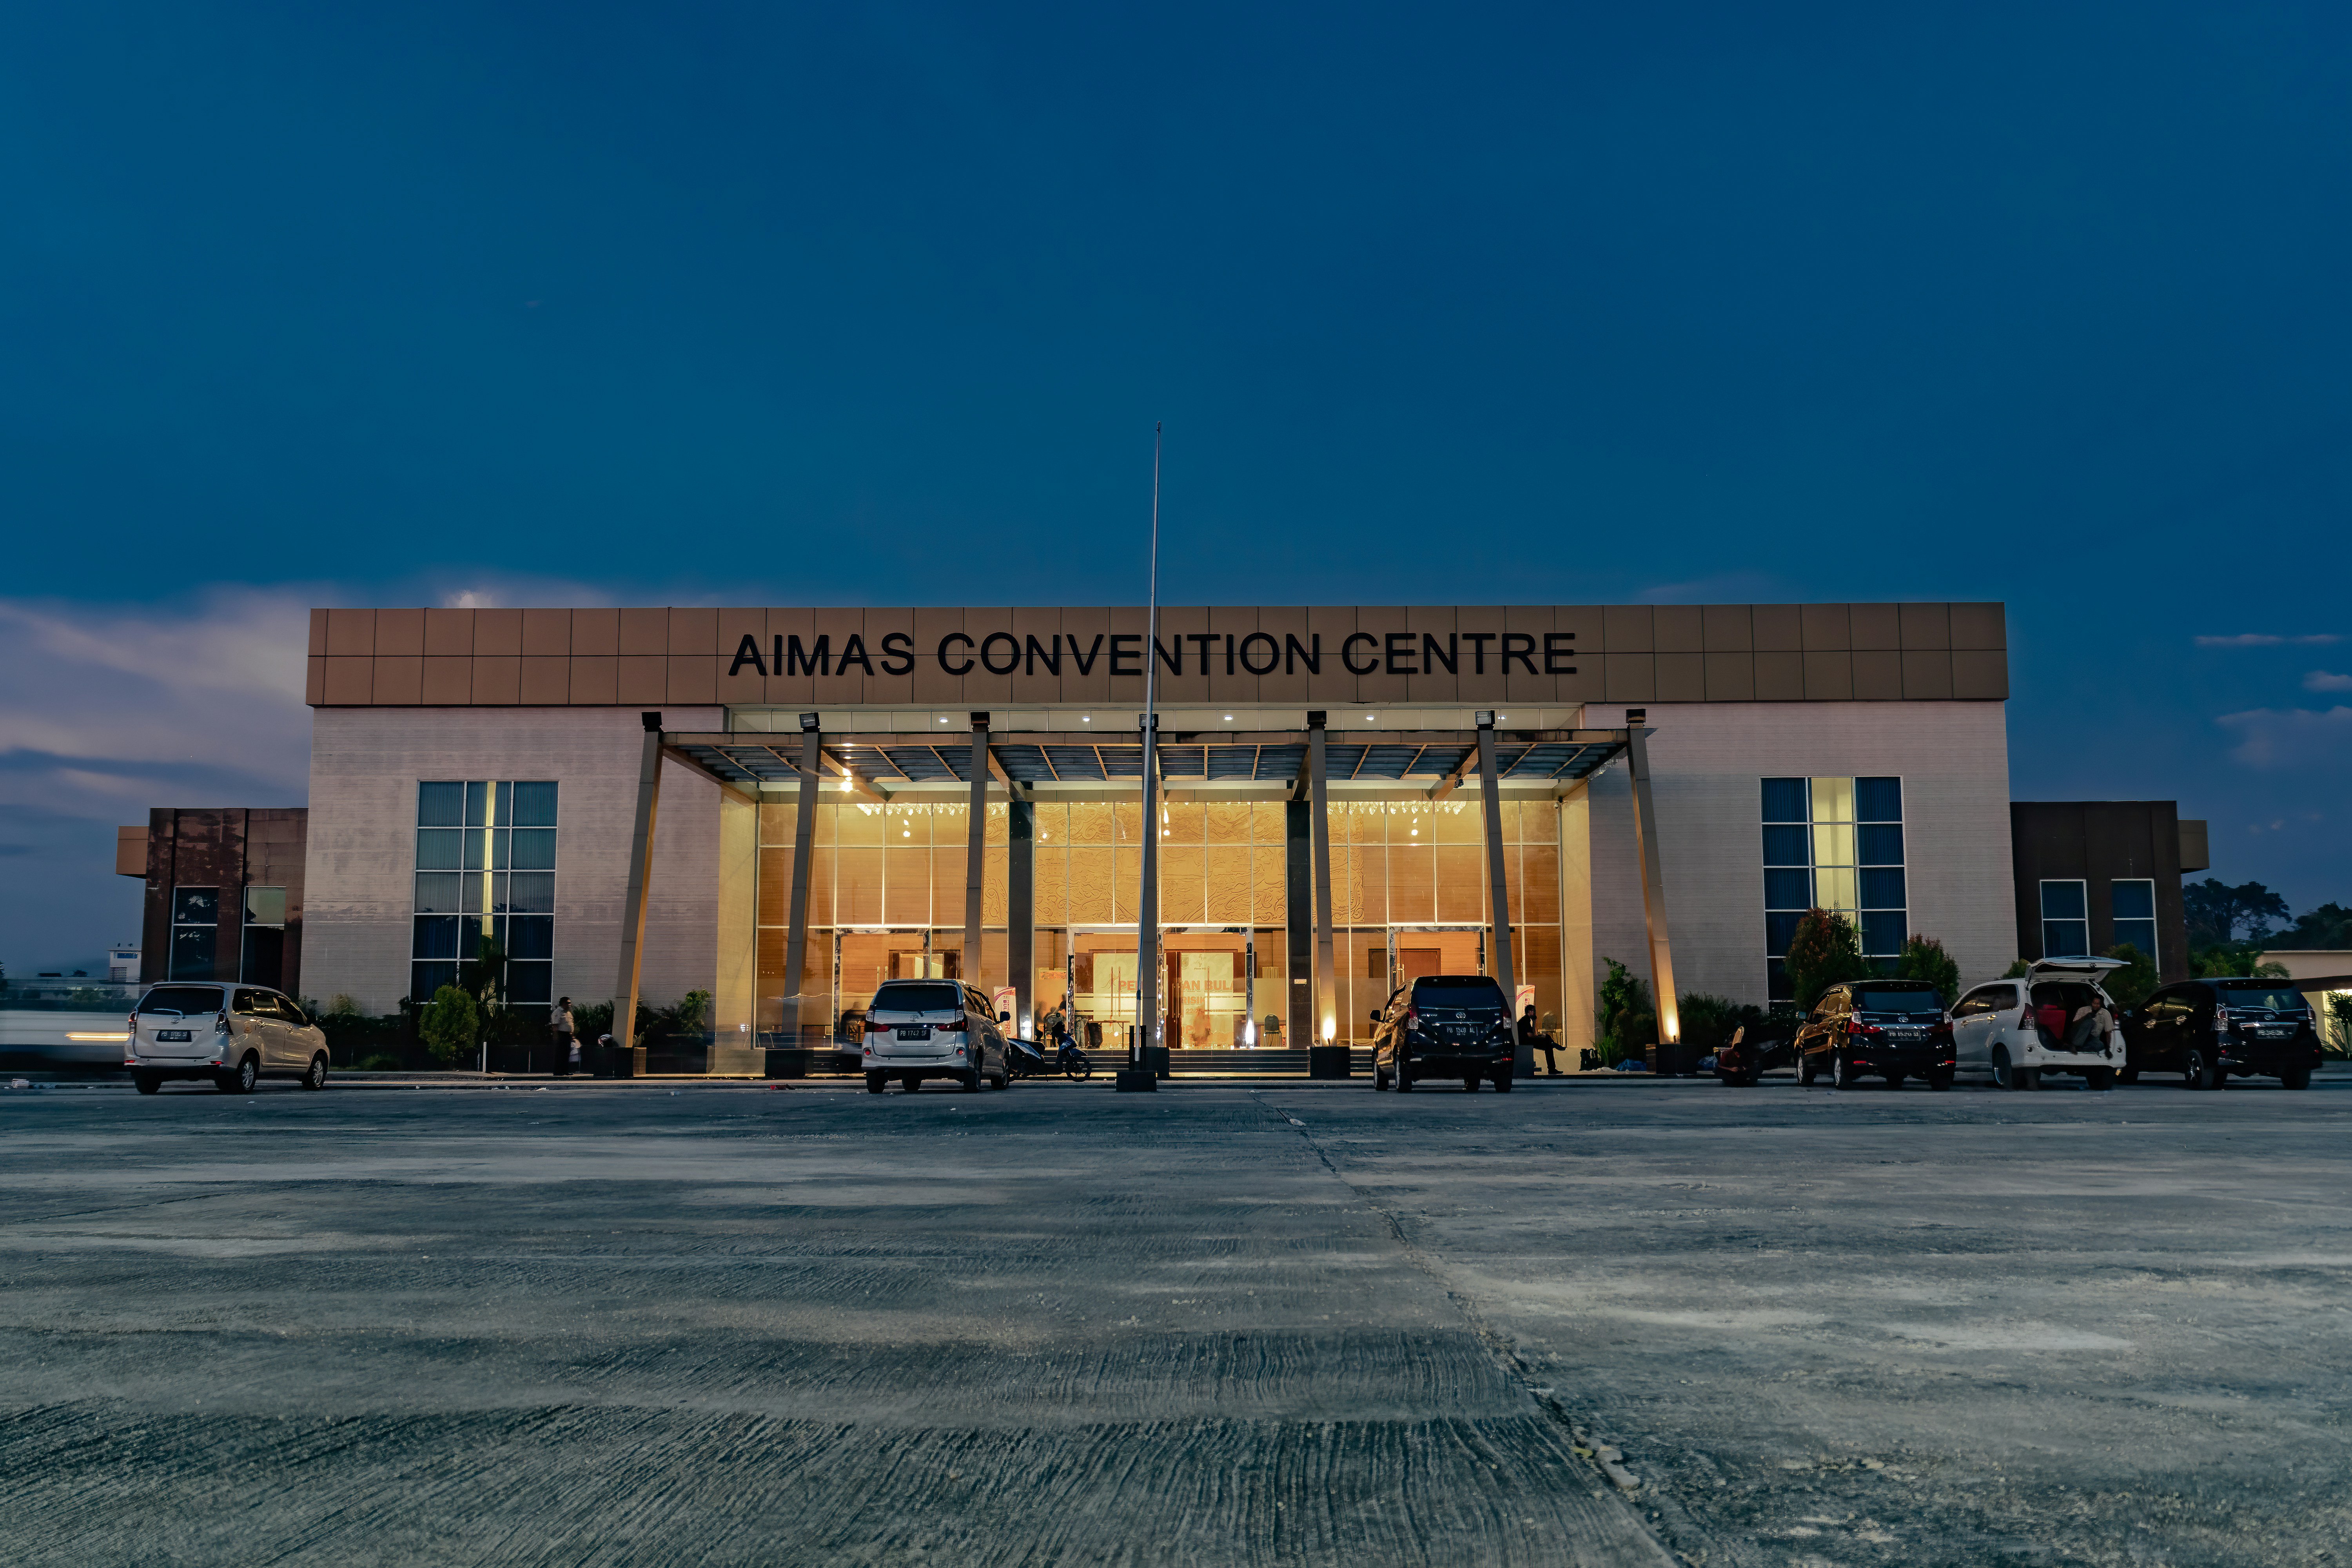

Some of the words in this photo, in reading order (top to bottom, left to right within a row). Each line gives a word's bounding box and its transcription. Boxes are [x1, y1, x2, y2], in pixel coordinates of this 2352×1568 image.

[729, 633, 915, 676] AIMAS
[938, 632, 1320, 676] CONVENTION
[1342, 632, 1577, 675] CENTRE
